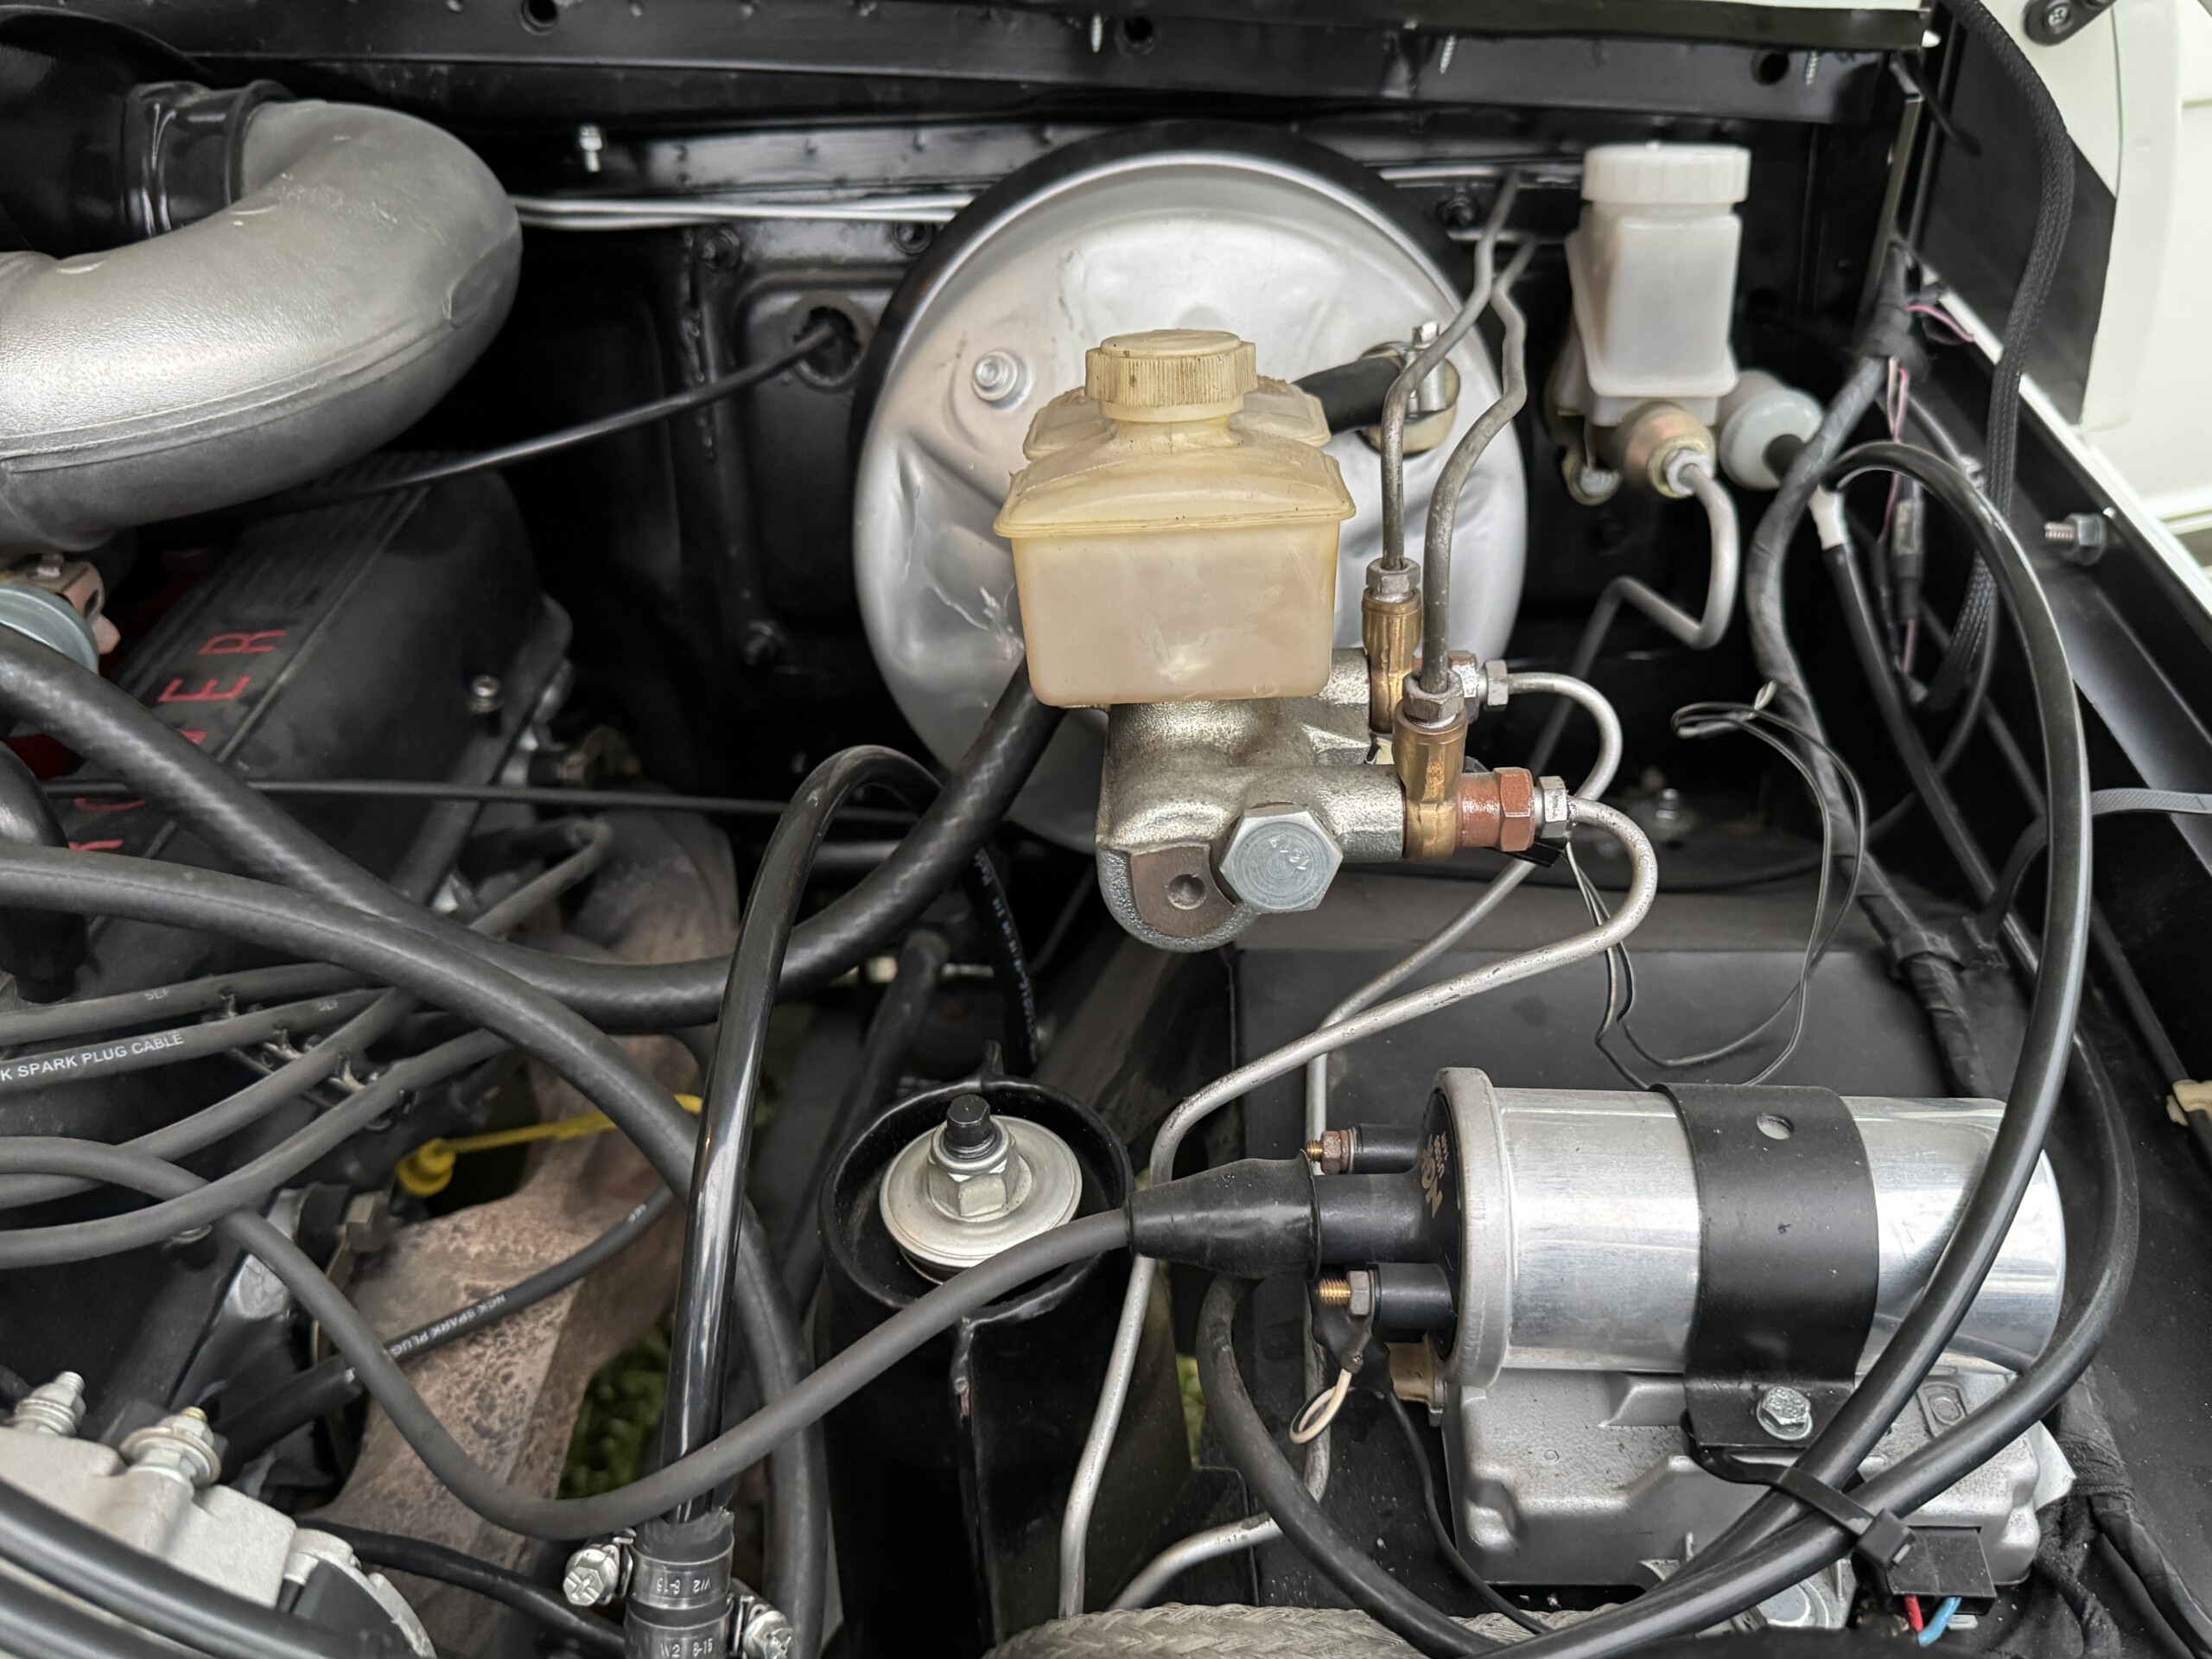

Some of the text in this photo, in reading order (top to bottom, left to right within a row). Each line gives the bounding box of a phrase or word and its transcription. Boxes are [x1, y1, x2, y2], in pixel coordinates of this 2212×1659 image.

[17, 1056, 78, 1078] SPARK
[81, 1046, 128, 1065] PLUG
[131, 1032, 185, 1055] CABLE
[430, 1307, 476, 1338] SPARK
[391, 1331, 429, 1358] PLUG
